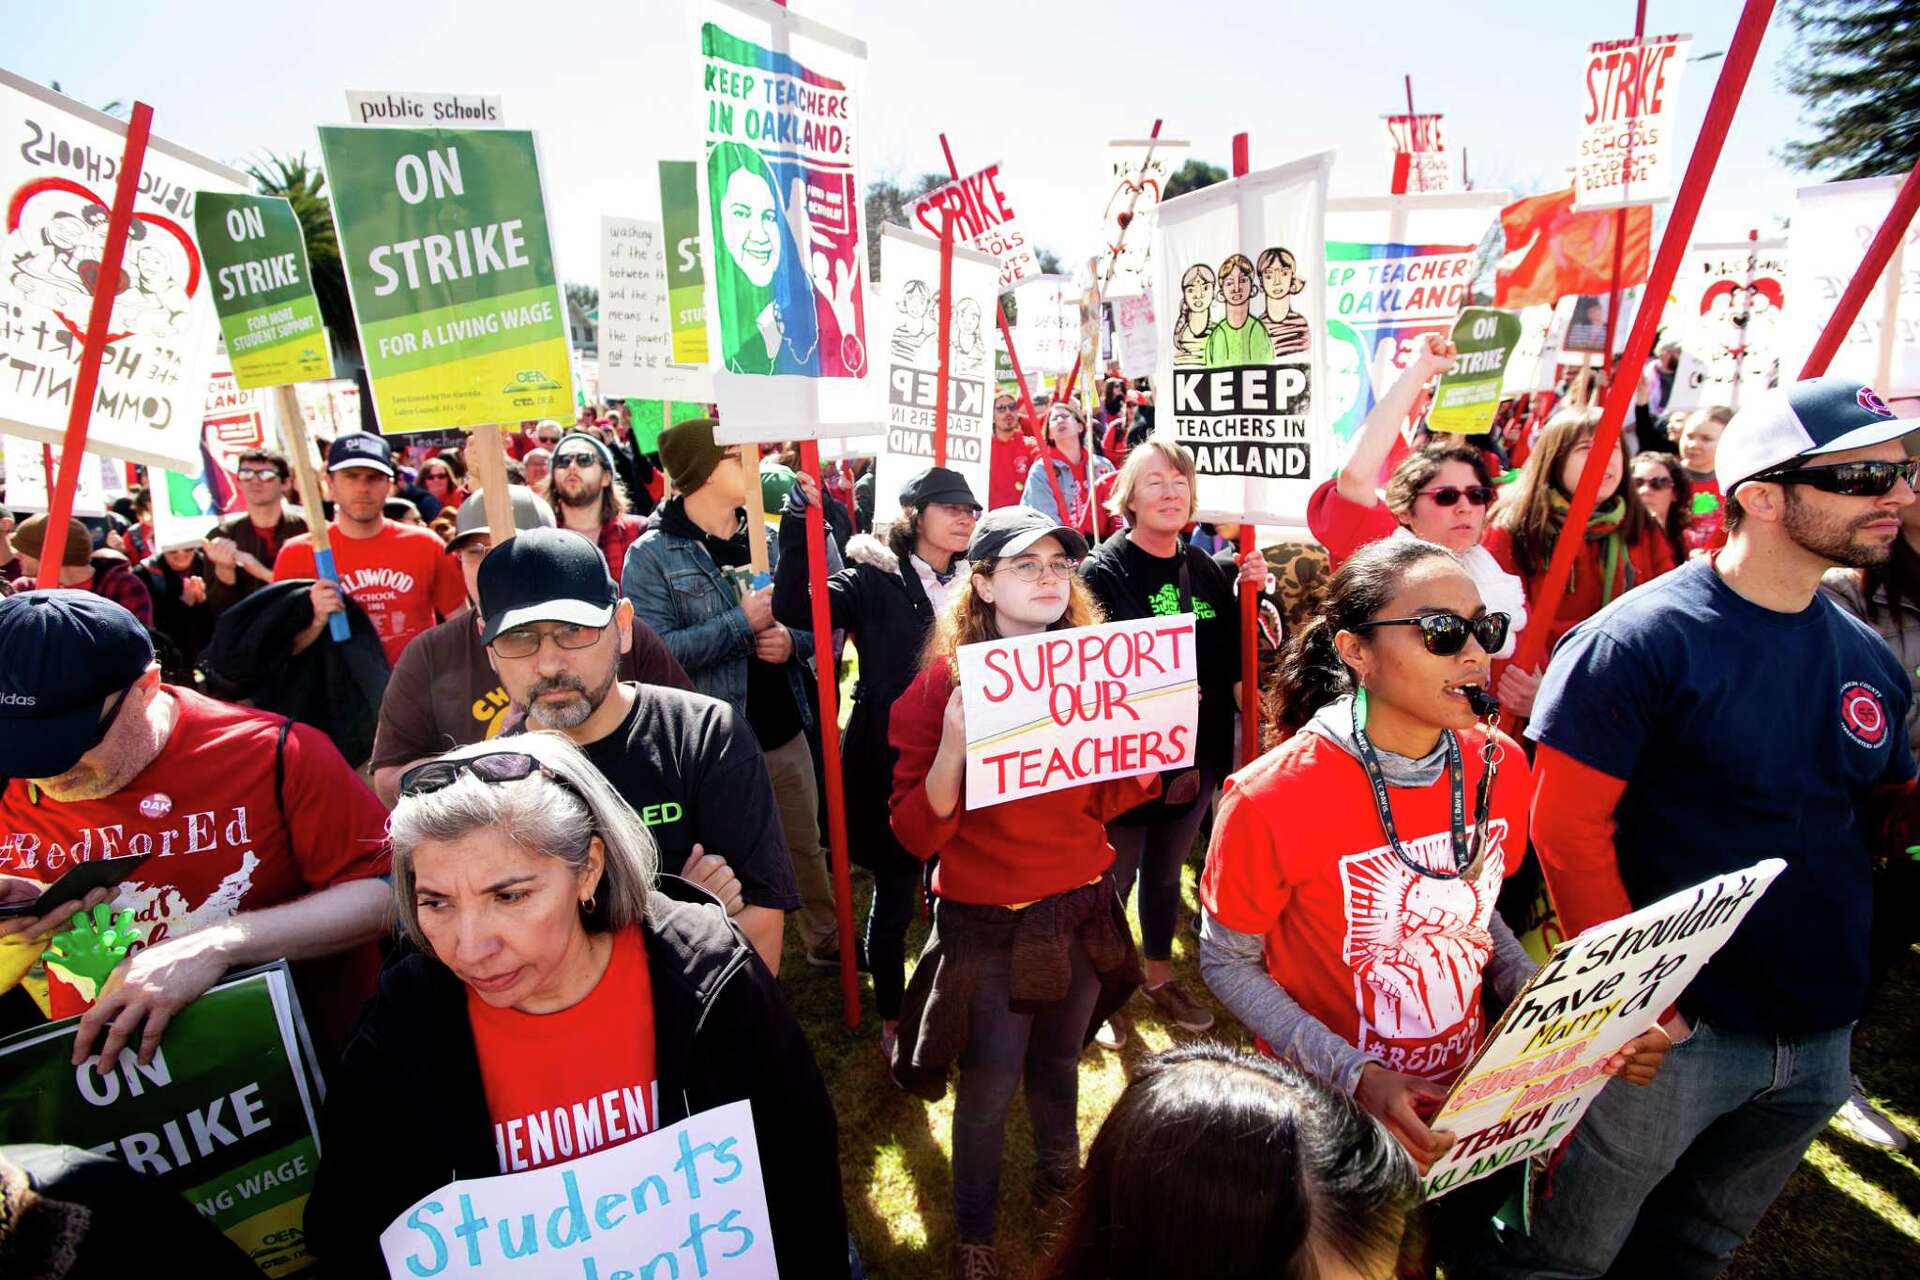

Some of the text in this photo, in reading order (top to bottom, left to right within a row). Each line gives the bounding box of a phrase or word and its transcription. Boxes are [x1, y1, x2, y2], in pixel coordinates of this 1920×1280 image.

[360, 95, 424, 123] public
[704, 64, 848, 119] KEEP TEACHERS
[1585, 45, 1677, 125] STRIKE
[708, 100, 733, 136] IN
[395, 147, 464, 204] ON
[226, 206, 266, 242] ON
[916, 164, 1015, 243] STRIKE
[218, 252, 300, 301] STRIKE
[368, 219, 529, 297] STRIKE
[1328, 259, 1474, 286] EP TEACHER
[233, 326, 278, 353] STUDENT
[247, 314, 269, 332] FOR
[379, 301, 553, 359] FOR A LIVING WAGE
[1472, 316, 1499, 340] ON
[1175, 368, 1307, 412] KEEP
[1177, 418, 1306, 438] TEACHERS IN
[340, 568, 414, 594] ILDWOOD
[353, 591, 397, 602] SCHOOL
[983, 625, 1193, 702] SUPPORT
[0, 692, 37, 706] idas
[1049, 681, 1140, 726] OUR
[982, 725, 1188, 795] TEACHERS
[140, 799, 171, 812] OAK
[1530, 945, 1573, 993] I
[1505, 954, 1687, 1034] have to
[1523, 981, 1660, 1054] Marry a
[76, 1048, 172, 1107] ON
[88, 1082, 272, 1176] RIKE
[1452, 1097, 1580, 1162] TEACH in
[235, 1156, 309, 1199] WAGE
[1427, 1121, 1567, 1196] KLAND!
[405, 1129, 743, 1278] Students
